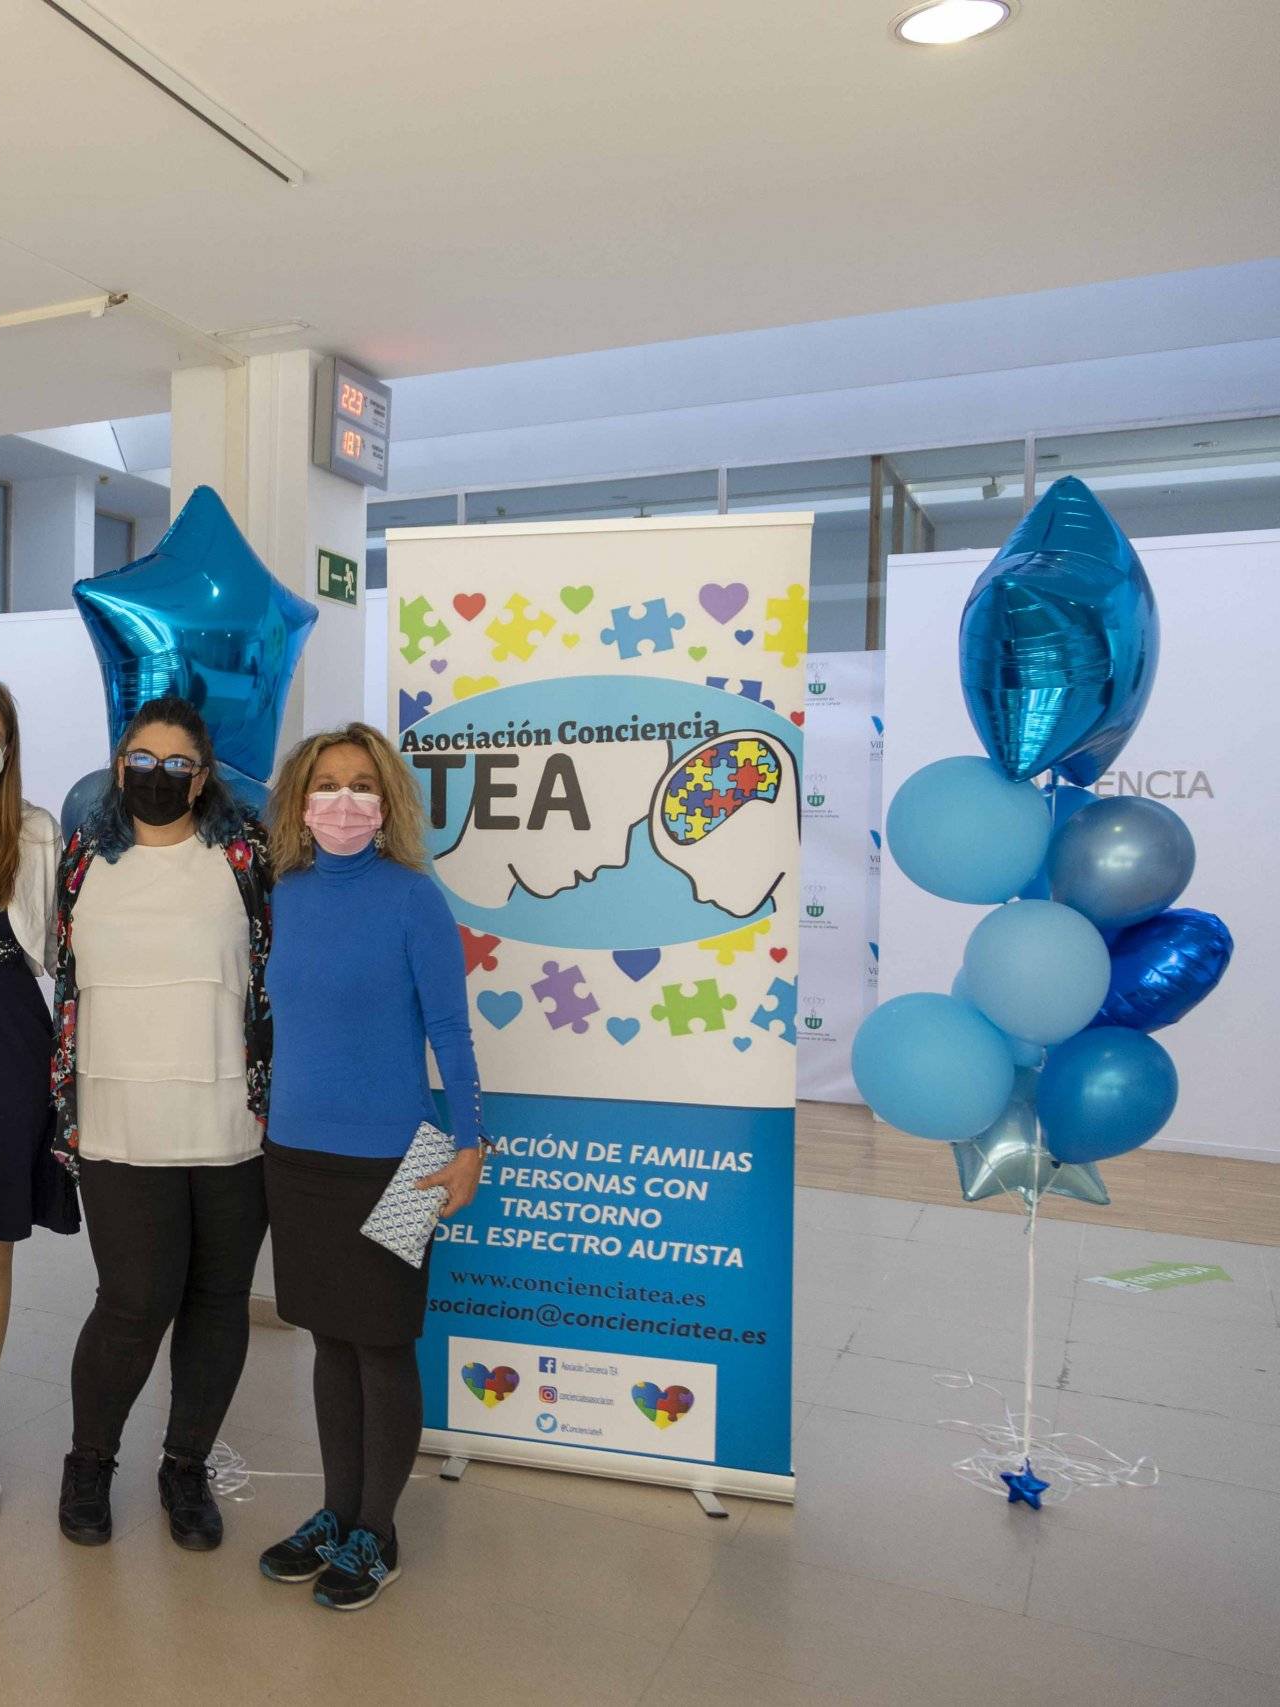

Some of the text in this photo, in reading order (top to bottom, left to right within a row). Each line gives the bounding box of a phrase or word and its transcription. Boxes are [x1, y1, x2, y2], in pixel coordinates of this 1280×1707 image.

[401, 711, 720, 752] Asociación Conciencia
[412, 753, 591, 830] TEA
[1095, 770, 1214, 799] ENCIA
[486, 1134, 754, 1173] ACIÓN DE FAMILIAS
[479, 1166, 709, 1201] E PERSONAS CON
[500, 1197, 662, 1229] TRASTORNO
[433, 1222, 745, 1268] DEL ESPECTRO AUTISTA
[450, 1270, 707, 1307] www.concienciatea.es
[428, 1296, 767, 1345] sociacion@concienciatea.es
